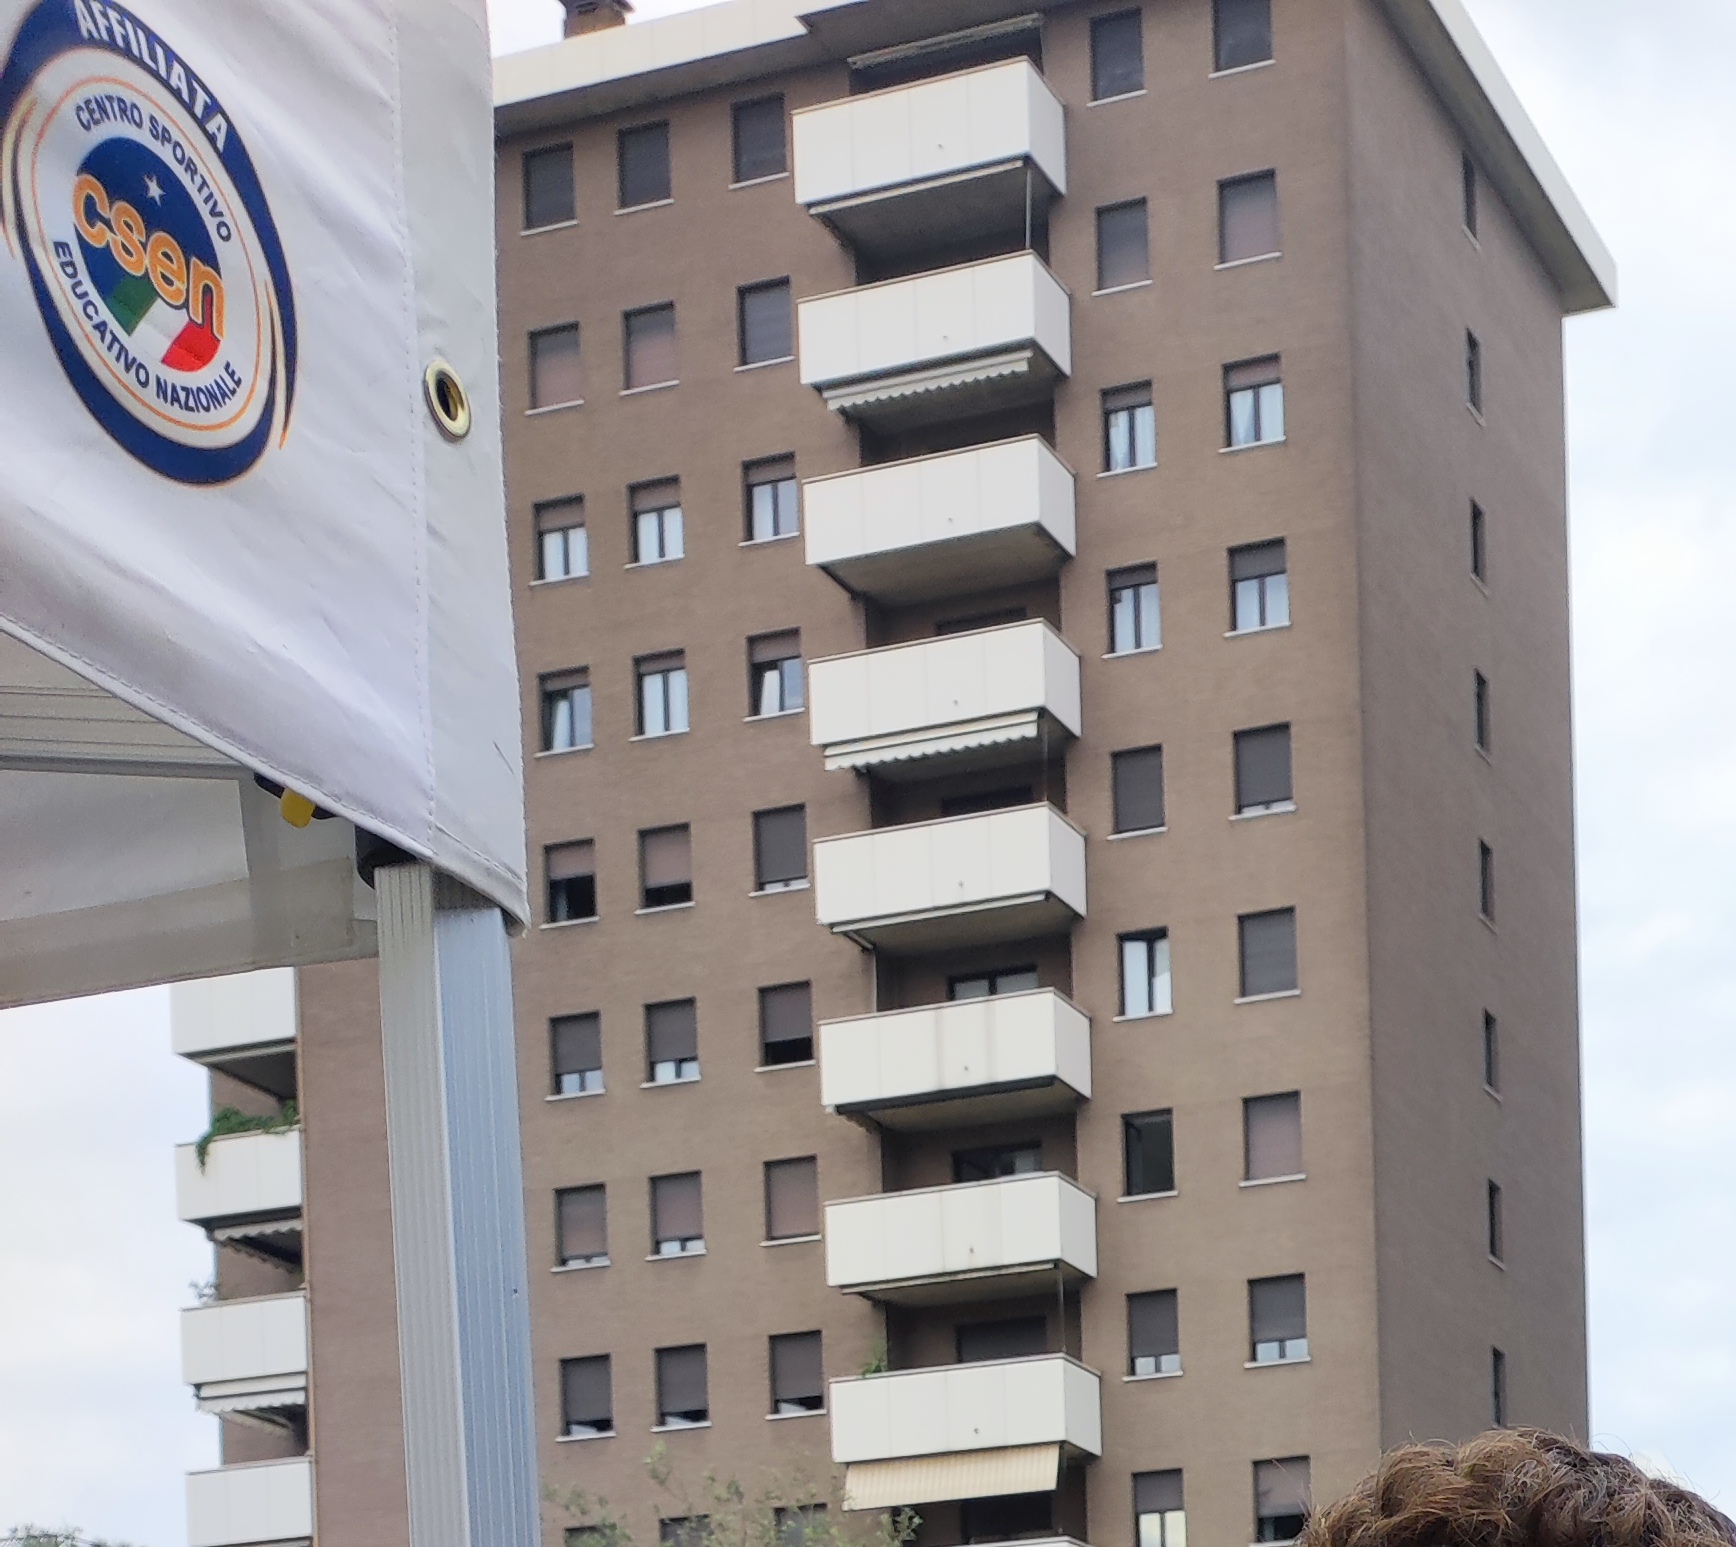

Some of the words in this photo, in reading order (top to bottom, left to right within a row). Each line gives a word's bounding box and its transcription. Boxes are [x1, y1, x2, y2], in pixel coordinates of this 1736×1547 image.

[74, 2, 230, 153] AFFILIATA
[76, 95, 144, 132] CENTRO
[149, 115, 233, 243] SPORTIVO
[54, 240, 150, 388] EDUCATIVO
[155, 361, 243, 414] NAZIONALE
